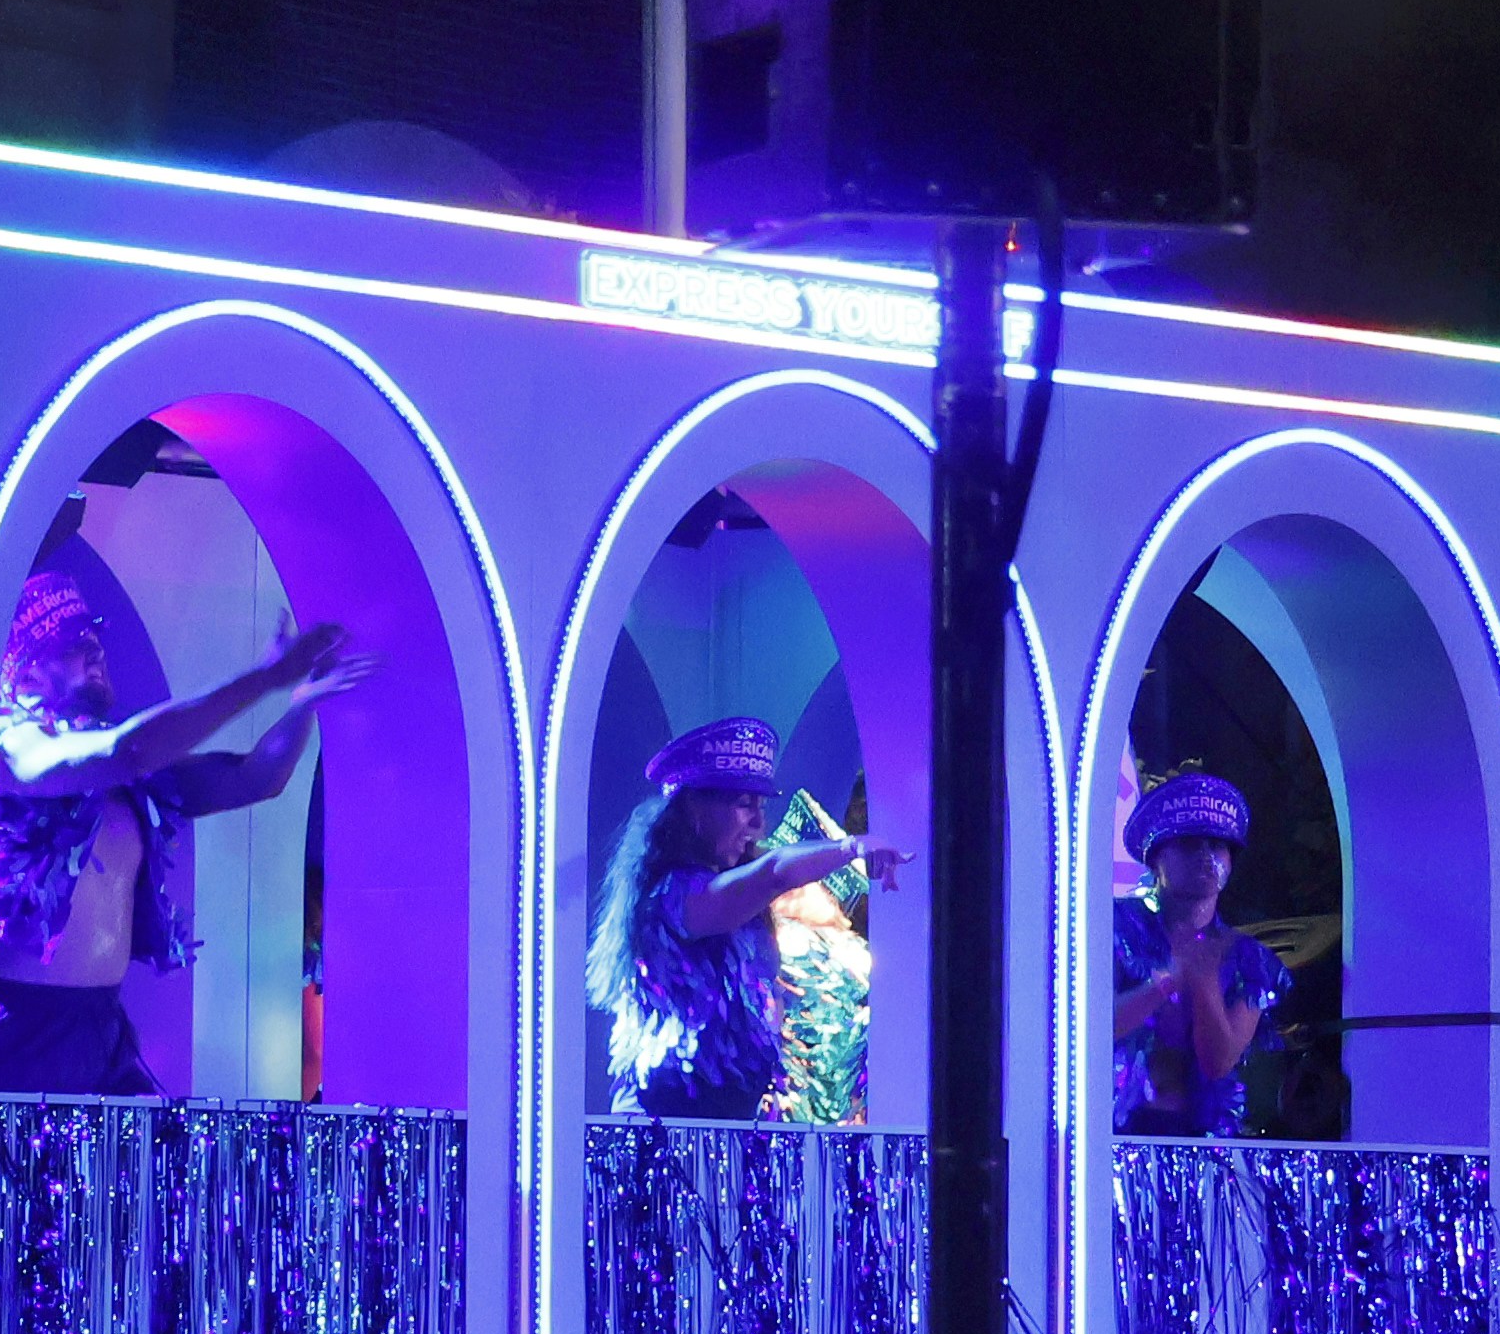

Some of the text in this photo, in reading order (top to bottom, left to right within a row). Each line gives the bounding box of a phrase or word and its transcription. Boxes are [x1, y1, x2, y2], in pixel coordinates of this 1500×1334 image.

[592, 255, 1033, 357] EXPRESS YOURF
[702, 740, 774, 761] AMERICAN
